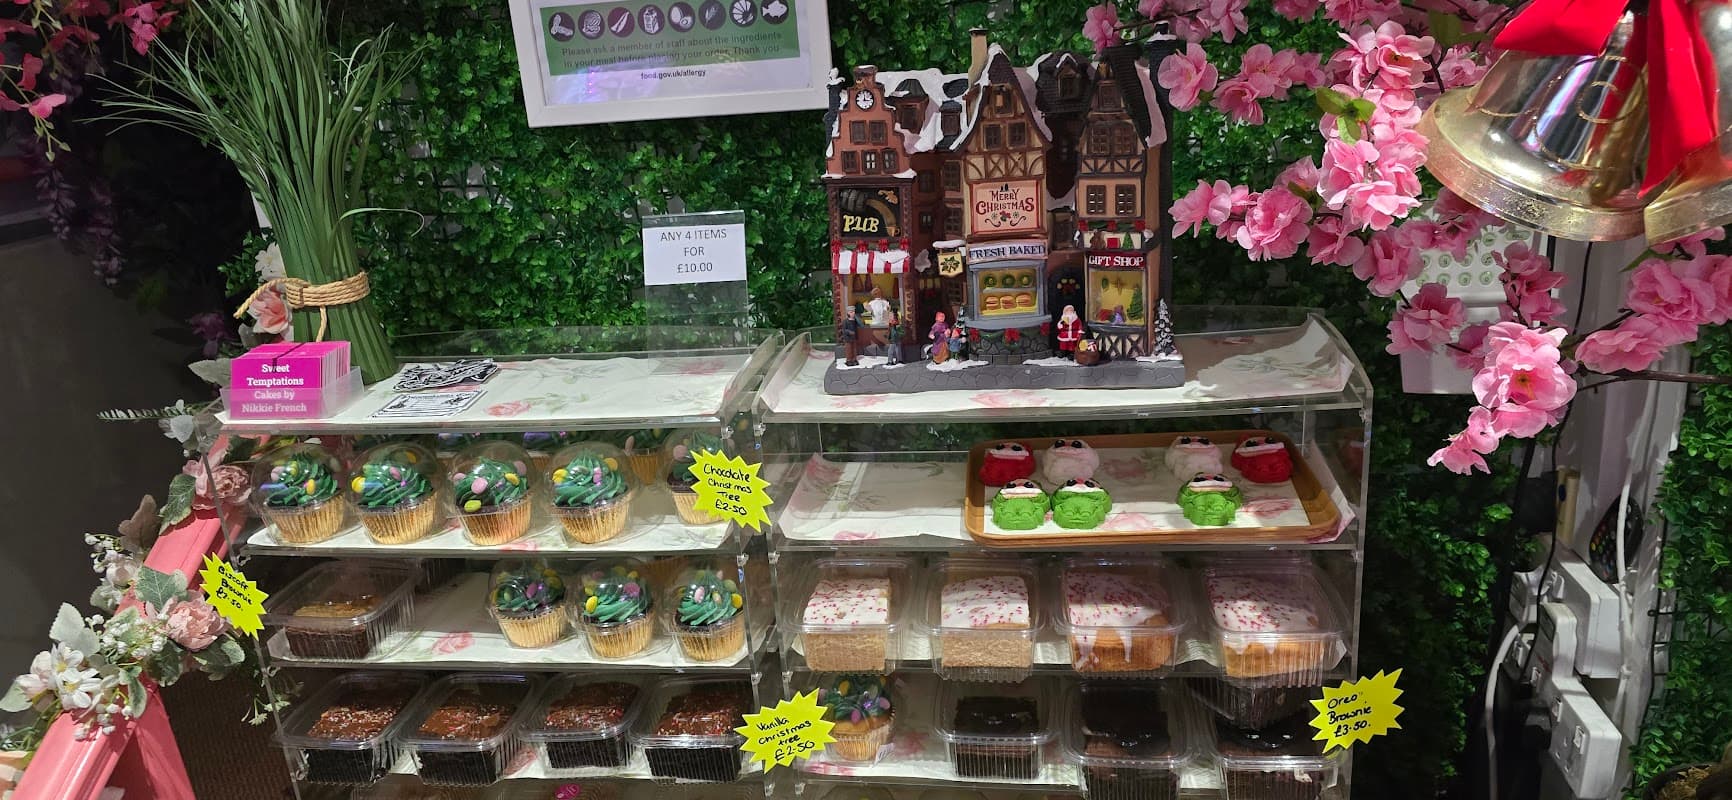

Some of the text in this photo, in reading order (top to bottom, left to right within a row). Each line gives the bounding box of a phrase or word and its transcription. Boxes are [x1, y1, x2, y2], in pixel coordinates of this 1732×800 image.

[562, 47, 592, 56] Please
[593, 45, 607, 54] ask
[618, 42, 652, 51] member
[656, 41, 664, 49] of
[667, 38, 685, 48] staff
[687, 38, 714, 47] about
[715, 35, 729, 44] the
[731, 31, 782, 44] ingredients
[682, 51, 702, 61] your
[734, 46, 760, 55] Thank
[763, 45, 780, 56] you
[640, 68, 706, 81] food.gov.uk/allergy
[989, 188, 1020, 202] MERRY
[975, 197, 1035, 215] CHRISTMAS
[842, 214, 879, 233] PUB
[660, 228, 727, 242] ANY 4 ITEMS
[684, 246, 705, 257] FOR
[969, 244, 1045, 259] FRESH BAKED
[677, 262, 713, 273] £10.00
[1088, 255, 1144, 267] GIFT SHOP
[262, 363, 290, 373] Sweet
[246, 376, 304, 388] Temptations
[254, 389, 295, 401] Cakes by
[242, 403, 307, 413] Nikkie French
[703, 463, 750, 483] Chocolate
[717, 491, 741, 502] Tree
[218, 565, 248, 591] Biscoff
[1327, 702, 1372, 725] Brownie
[756, 716, 789, 731] Vanilla
[778, 734, 800, 746] tree
